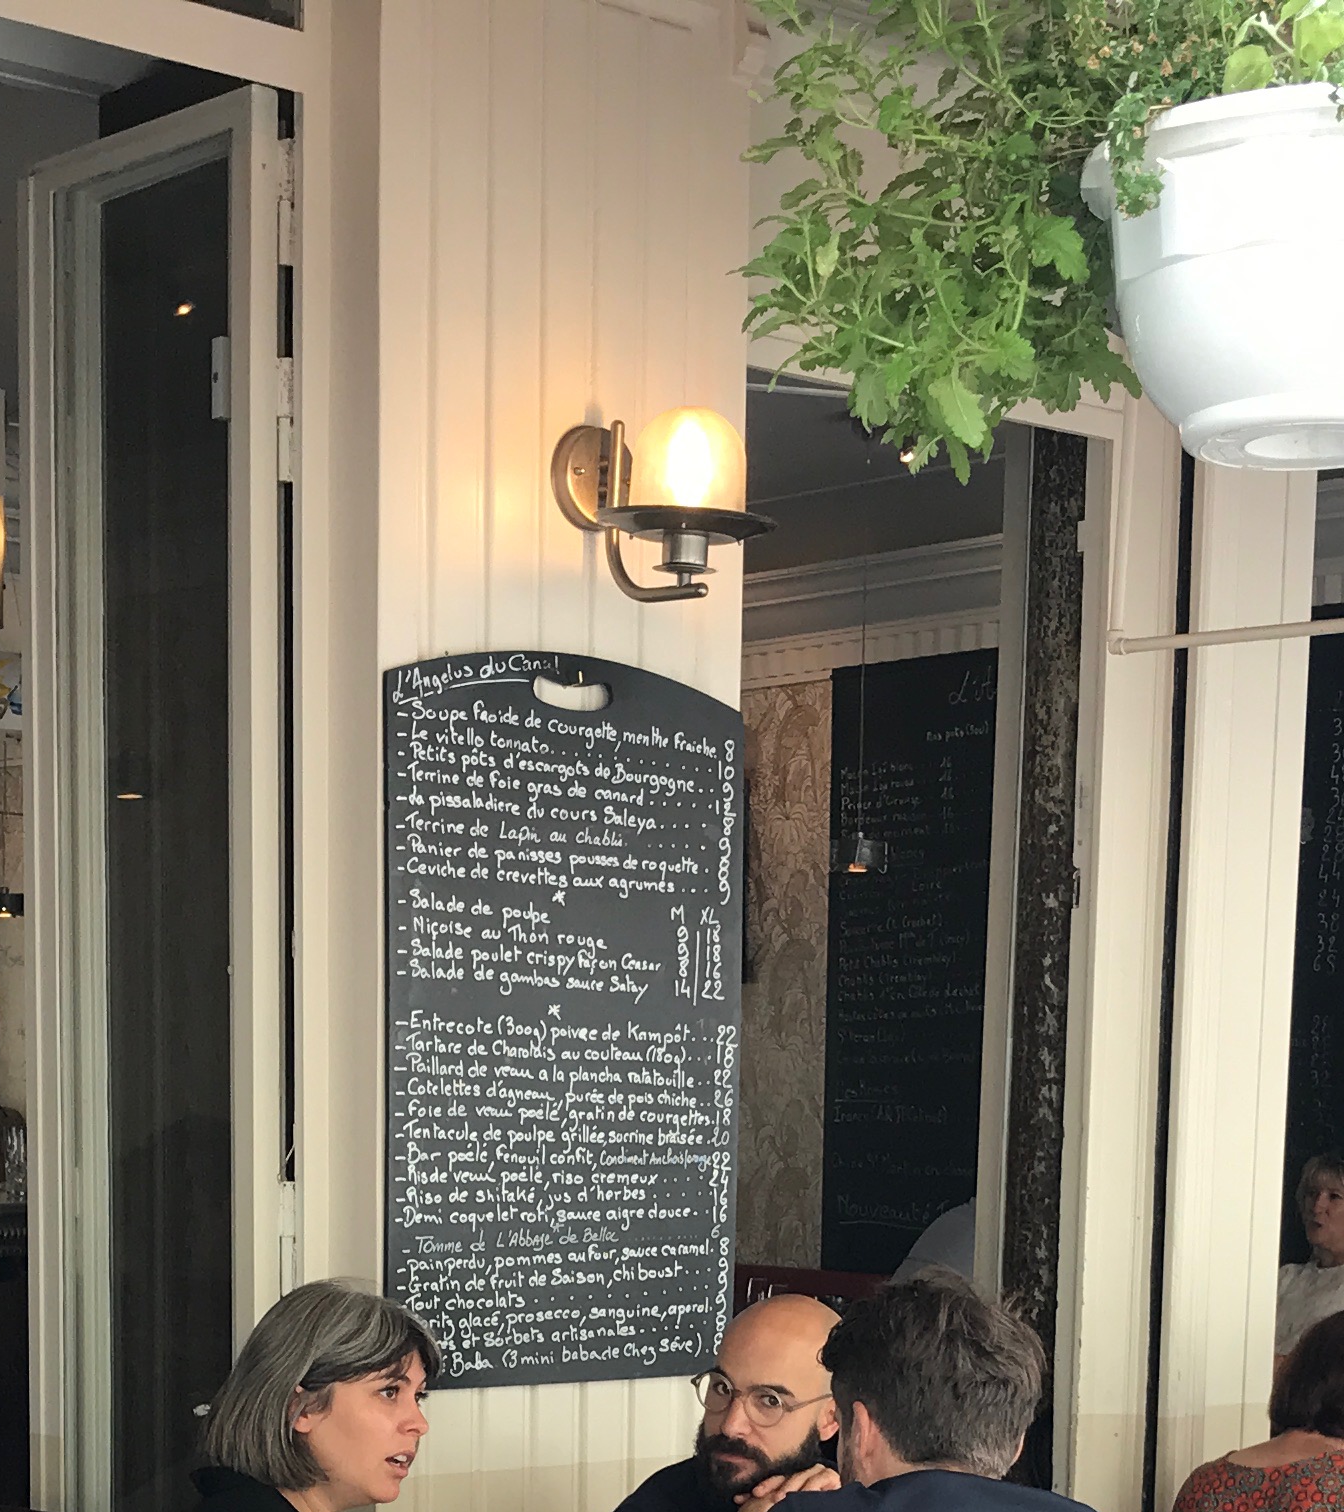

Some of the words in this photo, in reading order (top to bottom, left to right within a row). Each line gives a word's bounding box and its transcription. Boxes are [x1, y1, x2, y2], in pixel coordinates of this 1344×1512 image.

[412, 701, 468, 730] Soupe
[623, 726, 668, 748] menthe
[725, 740, 734, 762] 8
[412, 721, 428, 741] Le
[436, 727, 484, 746] vitello
[718, 760, 735, 780] 10
[407, 761, 459, 784] Terrine
[466, 770, 484, 788] de
[490, 770, 520, 789] foie
[527, 782, 562, 802] gras
[595, 788, 643, 806] canard
[410, 741, 456, 763] Petits
[503, 752, 590, 782] d'escargots
[611, 763, 694, 796] Bourgogne
[723, 782, 734, 802] 9
[405, 811, 464, 834] Terrine
[470, 818, 488, 837] de
[550, 831, 567, 843] au
[429, 791, 520, 816] pissaladiere
[527, 803, 544, 819] du
[551, 807, 597, 821] cours
[604, 806, 656, 835] Saleya
[407, 833, 461, 857] Panier
[468, 842, 488, 858] de
[494, 849, 562, 868] panisses
[569, 854, 619, 874] pousses
[642, 856, 698, 880] roquette
[407, 857, 465, 878] Ceviche
[470, 862, 488, 879] de
[497, 867, 568, 888] crevettes
[573, 876, 604, 888] aux
[719, 880, 731, 905] 9
[409, 889, 465, 913] Salade
[471, 899, 493, 915] de
[706, 925, 721, 944] 18
[670, 905, 685, 924] M
[700, 906, 719, 925] XL
[411, 938, 463, 960] Salade
[471, 943, 522, 970] poulet
[527, 951, 575, 976] crispy
[706, 961, 722, 979] 16
[481, 929, 501, 940] au
[507, 924, 549, 944] Thon
[557, 934, 607, 960] rouge
[706, 944, 721, 962] 18
[409, 959, 464, 980] Salade
[474, 964, 495, 981] de
[499, 969, 560, 995] gambas
[610, 974, 648, 1004] Satay
[675, 978, 690, 998] 14
[701, 980, 725, 1000] 22
[410, 1009, 493, 1035] Entrecote
[602, 1023, 620, 1041] de
[716, 1024, 738, 1047] 22
[406, 1031, 462, 1053] Tartare
[467, 1039, 488, 1056] de
[561, 1050, 580, 1060] au
[584, 1043, 643, 1061] couteau
[717, 1044, 734, 1068] 18
[406, 1052, 463, 1077] Paillard
[494, 1065, 534, 1079] veau
[569, 1065, 622, 1093] plancha
[627, 1067, 694, 1089] ratatouille
[714, 1069, 732, 1089] 22
[408, 1077, 481, 1096] Cotelettes
[566, 1089, 604, 1111] purée
[628, 1092, 654, 1110] pois
[657, 1089, 696, 1108] chiche
[714, 1089, 733, 1108] 26
[403, 1119, 477, 1141] Tentacule
[507, 1124, 556, 1150] poulpe
[476, 1106, 512, 1117] veau
[569, 1106, 615, 1132] gratin
[407, 1141, 441, 1164] Bar
[712, 1151, 731, 1170] 22
[552, 1170, 583, 1184] riso
[406, 1186, 442, 1208] Riso
[546, 1193, 571, 1210] jus
[578, 1185, 646, 1202] d'herbes
[403, 1206, 442, 1227] Demi
[450, 1204, 518, 1232] coquelet
[557, 1210, 601, 1222] sauce
[606, 1207, 644, 1231] aigre
[648, 1202, 690, 1220] douce
[713, 1205, 727, 1223] 16
[711, 1224, 721, 1239] 6
[494, 1252, 563, 1277] pommes
[621, 1246, 658, 1260] sauce
[719, 1236, 730, 1256] 8
[408, 1274, 460, 1294] Gratin
[613, 1260, 683, 1281] chiboust
[405, 1293, 441, 1313] Tout
[445, 1290, 526, 1311] chocolats
[462, 1333, 480, 1349] et
[551, 1320, 636, 1341] artisanales
[450, 1351, 494, 1377] Baba
[521, 1351, 554, 1365] mini
